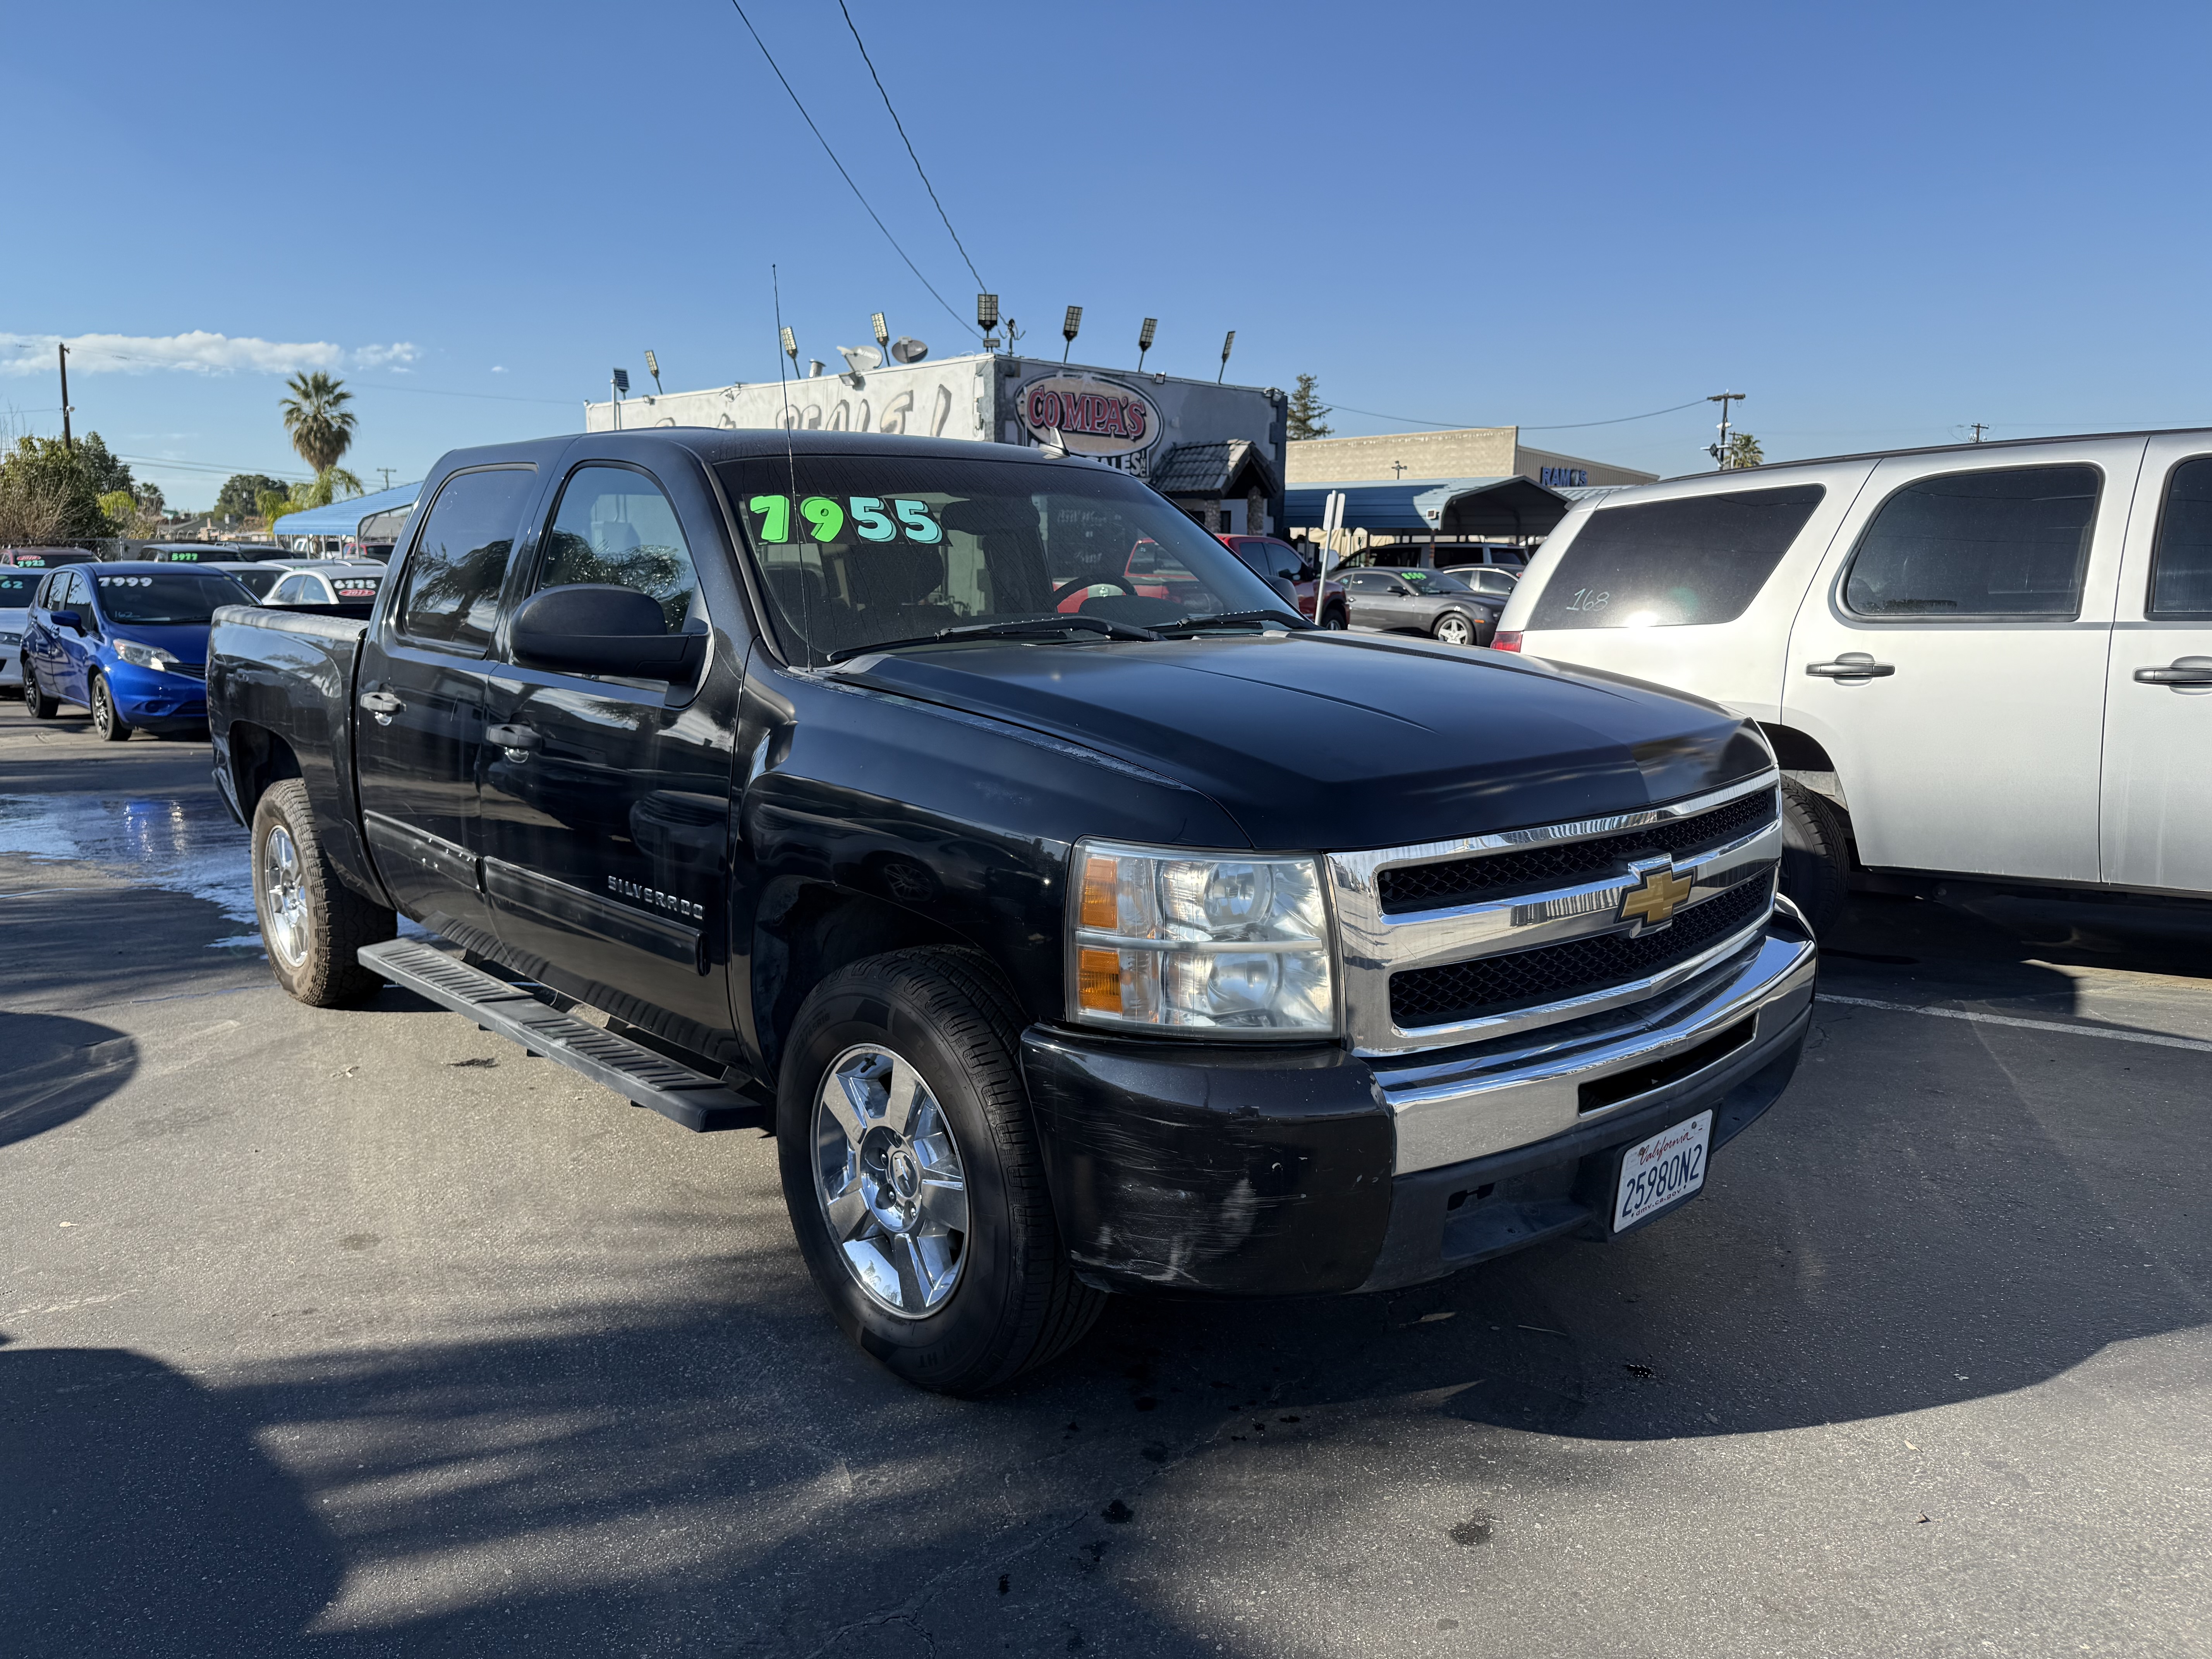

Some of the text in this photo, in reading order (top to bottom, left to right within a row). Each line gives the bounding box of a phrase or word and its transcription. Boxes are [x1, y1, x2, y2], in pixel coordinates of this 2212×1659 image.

[1028, 385, 1146, 440] COMPA'S
[1085, 452, 1141, 476] LES
[1541, 467, 1587, 487] RAMOS
[750, 495, 942, 543] 7955
[98, 577, 153, 587] 7999
[1566, 588, 1609, 611] 168
[608, 875, 704, 920] SILVERADO
[1640, 1128, 1695, 1165] California
[1622, 1144, 1702, 1218] 25980N2
[1635, 1188, 1681, 1216] dmv.ca.gov
